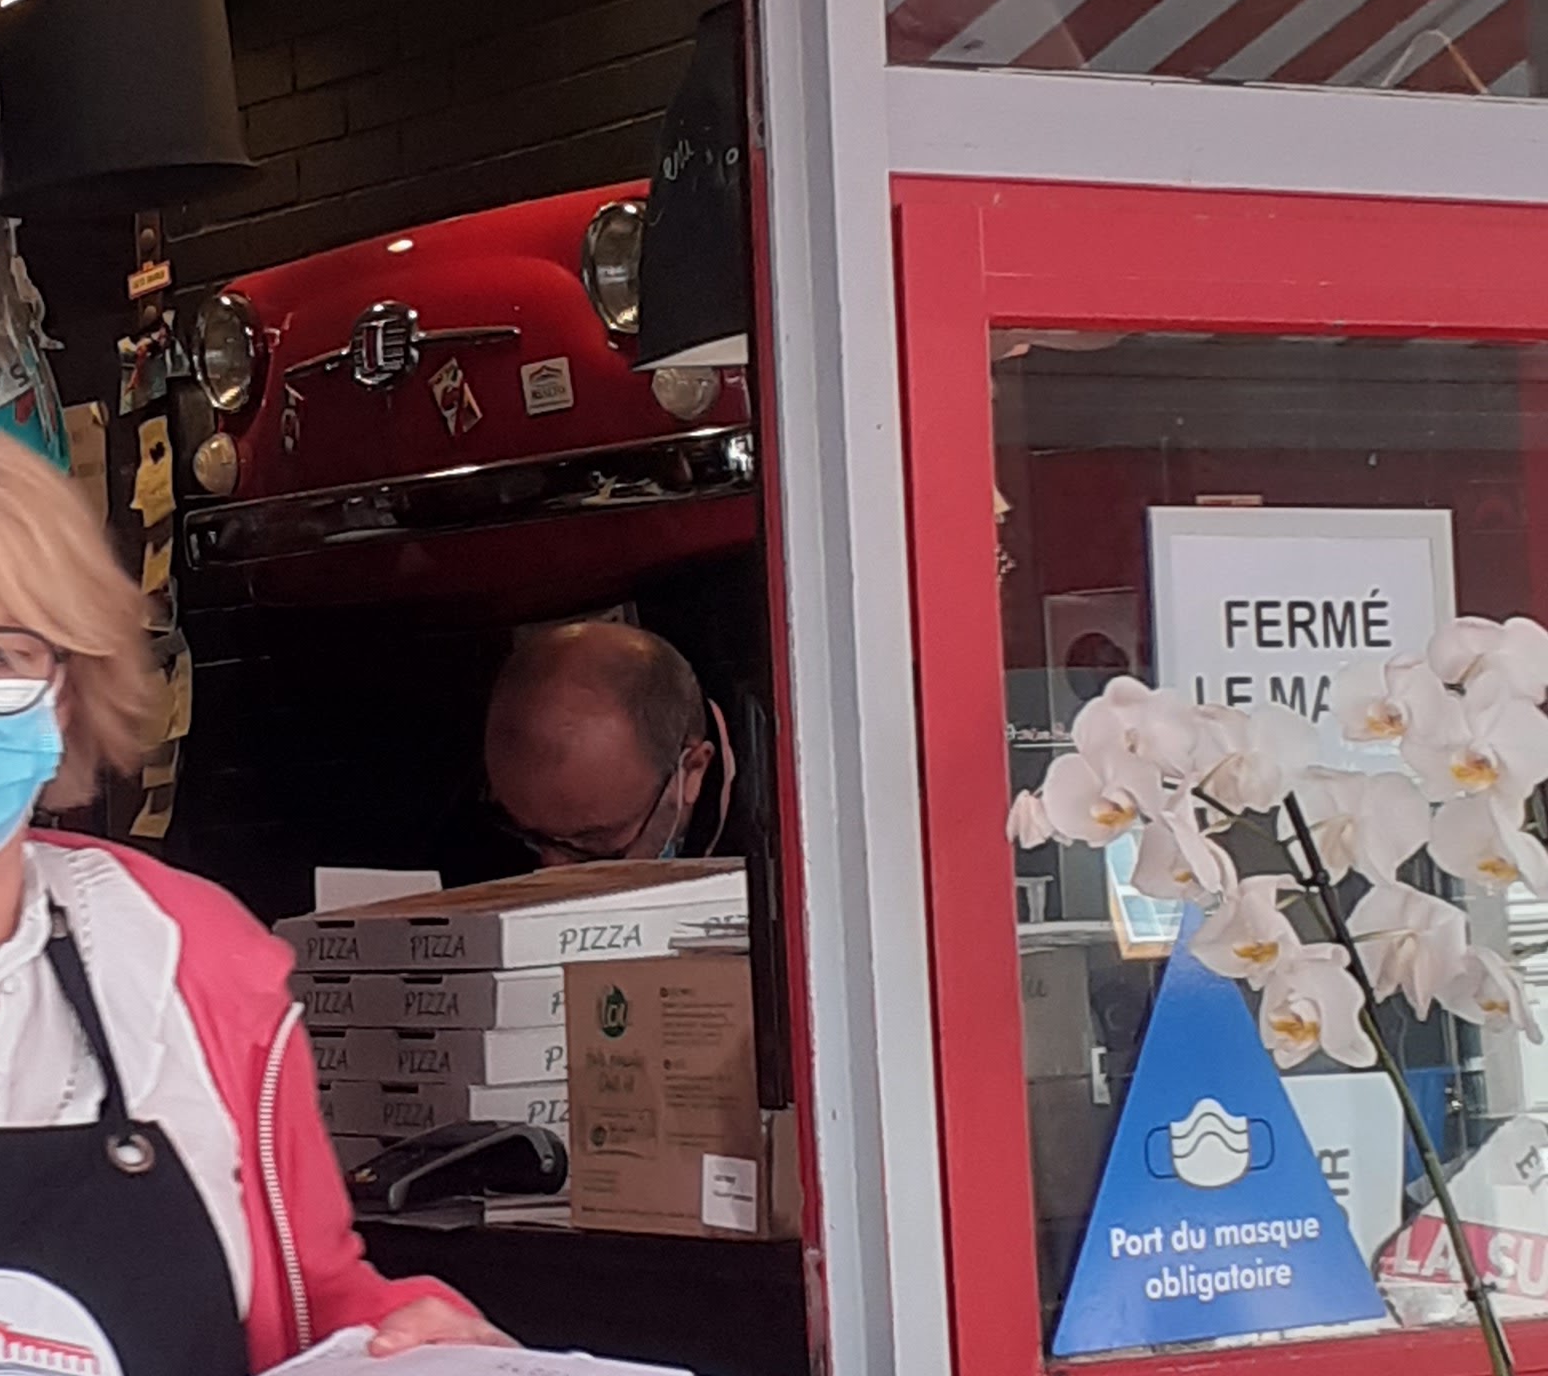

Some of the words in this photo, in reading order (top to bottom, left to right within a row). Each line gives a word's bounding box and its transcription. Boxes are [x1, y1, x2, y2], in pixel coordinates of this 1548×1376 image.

[1224, 588, 1392, 649] FERMÉ
[1269, 675, 1332, 724] MA
[306, 935, 360, 960] PIZZA
[409, 935, 467, 959] PIZZA
[558, 923, 642, 954] PIZZA
[403, 991, 460, 1016] PIZZA
[313, 1046, 348, 1071] ZZA
[397, 1049, 452, 1074] PIZZA
[383, 1102, 436, 1127] PIZZA
[527, 1099, 570, 1124] PIZ
[1109, 1226, 1163, 1258] Port
[1170, 1221, 1207, 1251] du
[1214, 1216, 1320, 1251] masque
[1144, 1261, 1293, 1303] obligatoire
